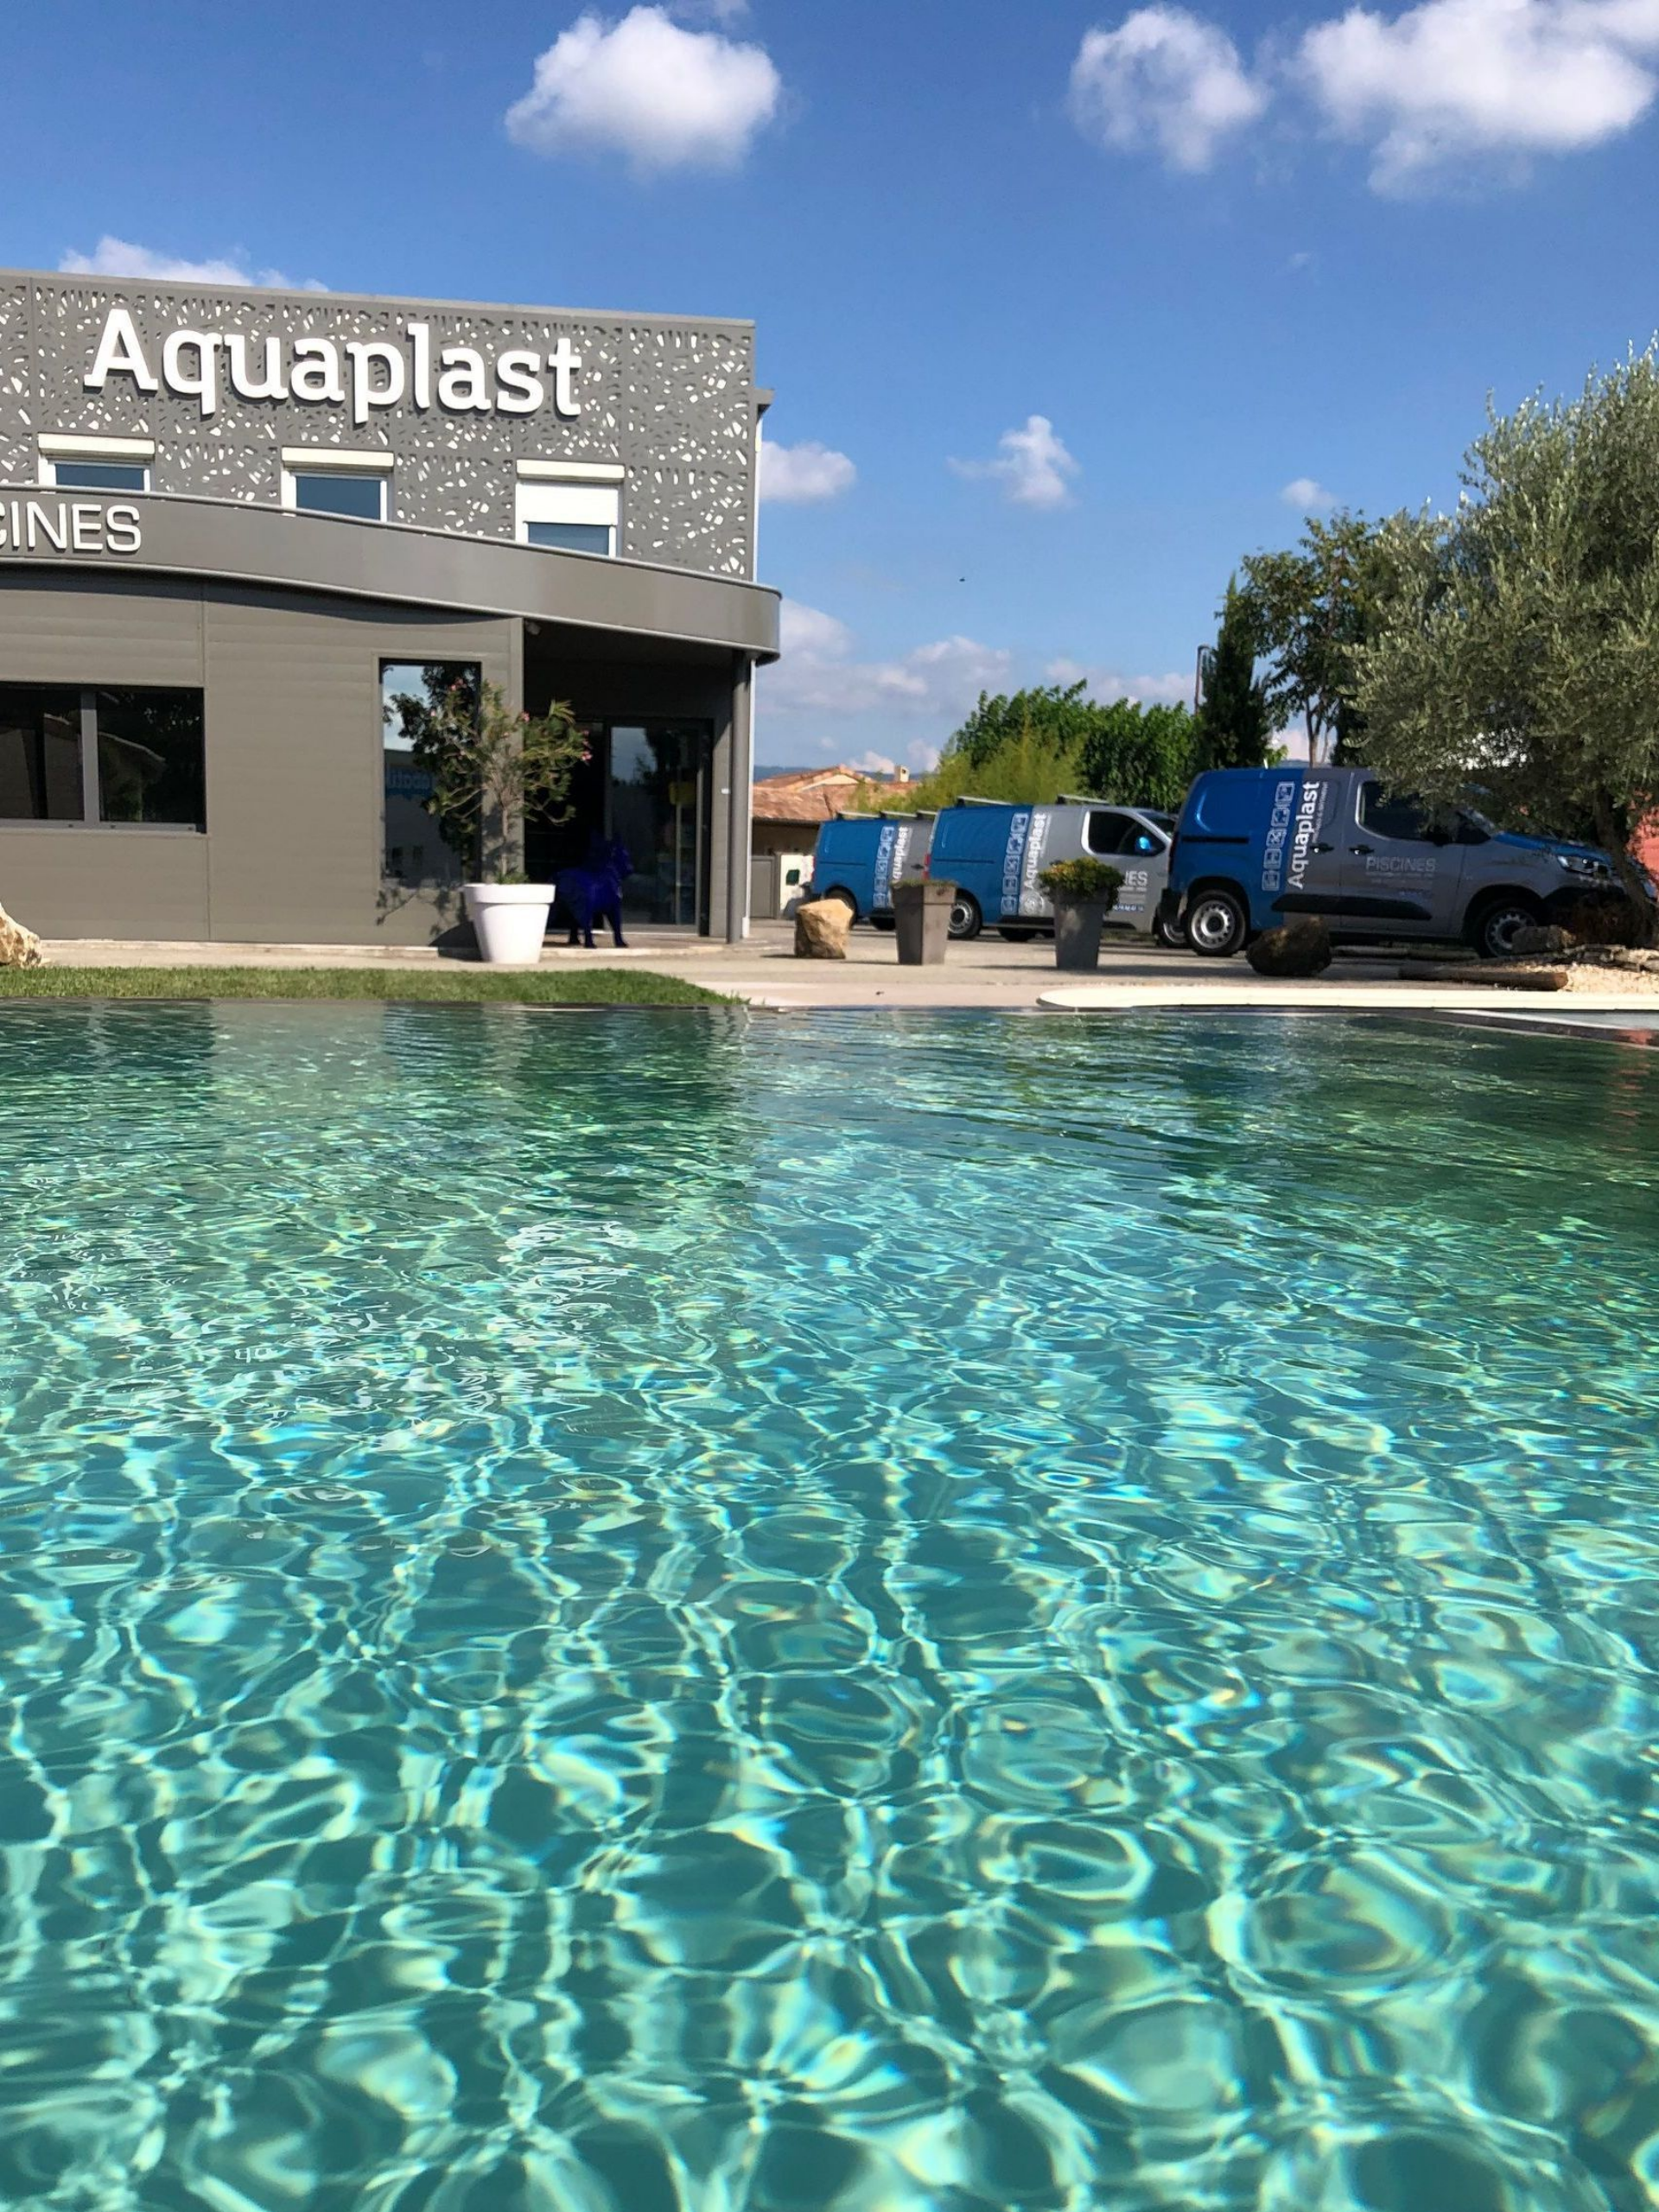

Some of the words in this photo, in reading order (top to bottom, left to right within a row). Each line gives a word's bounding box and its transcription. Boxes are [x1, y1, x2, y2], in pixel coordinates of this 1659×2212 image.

[84, 308, 582, 423] Aquaplast
[0, 500, 142, 552] INES
[892, 826, 909, 883] quaplast
[1023, 813, 1046, 889] Aquaplast
[1287, 780, 1320, 890] Aquaplast
[1365, 855, 1436, 873] PISCINES
